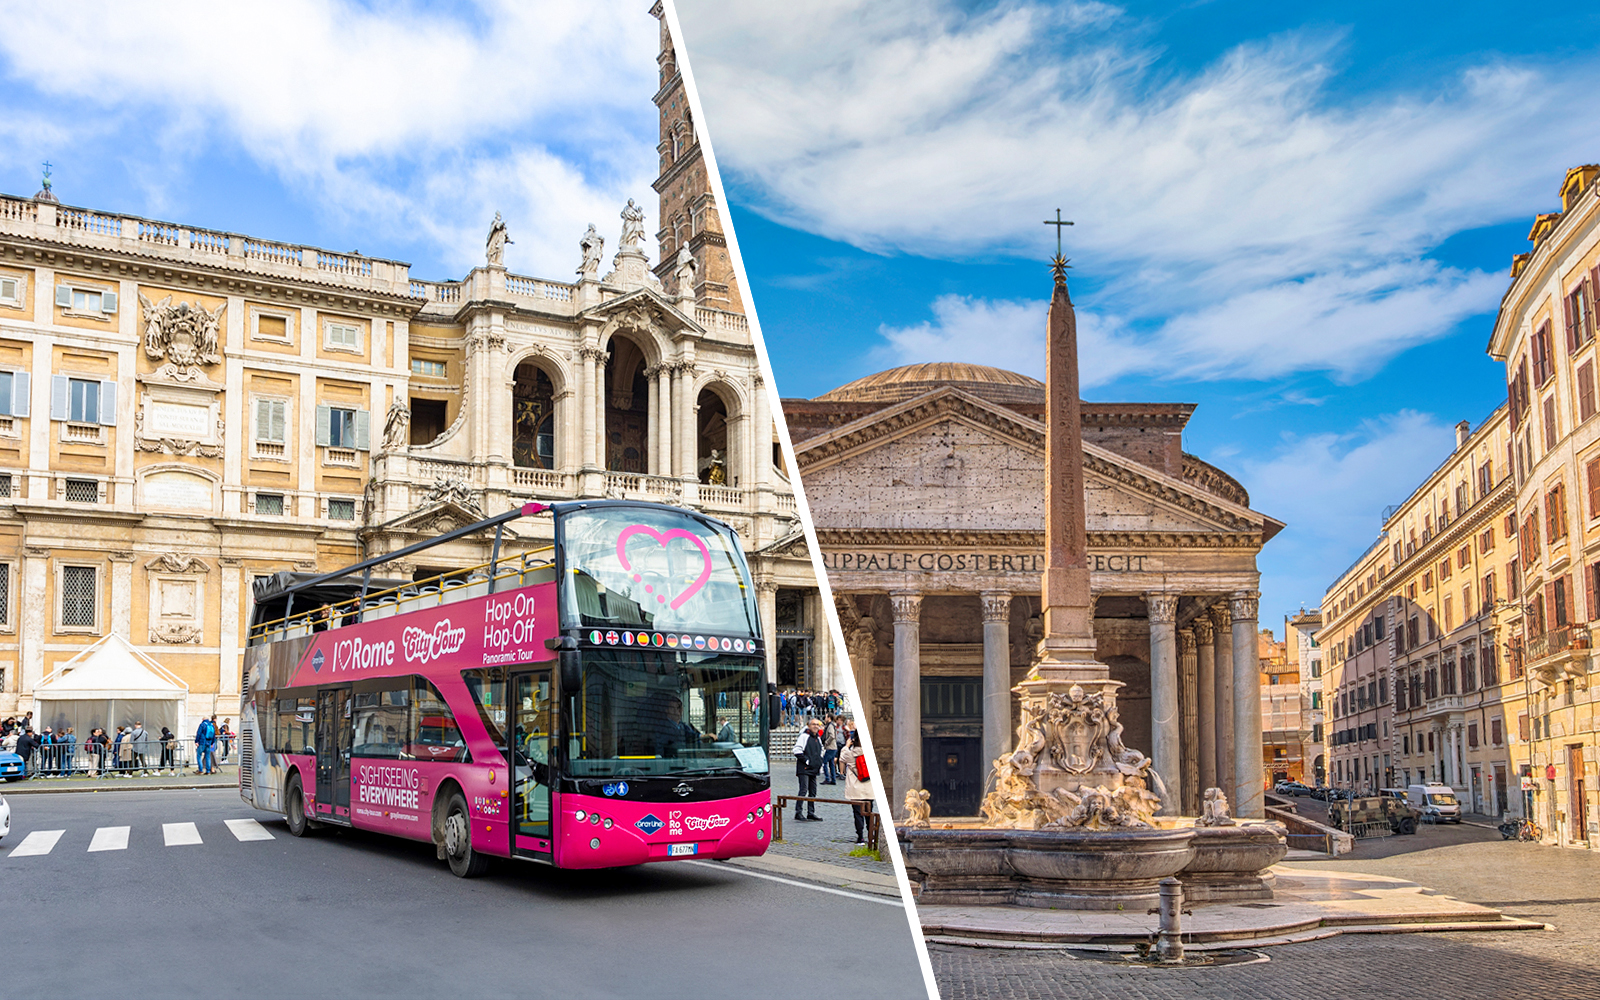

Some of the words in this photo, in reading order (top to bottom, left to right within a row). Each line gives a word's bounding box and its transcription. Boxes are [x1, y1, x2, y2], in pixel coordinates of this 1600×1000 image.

[485, 593, 535, 625] Hop-On
[483, 617, 536, 652] Hop-Off
[332, 642, 338, 673] I
[352, 637, 395, 670] Rome
[482, 650, 516, 665] Panoramic
[517, 648, 534, 661] Tour
[360, 765, 419, 789] SIGHTSEEING
[360, 785, 418, 809] EVERYWHERE
[669, 820, 680, 828] Ro
[669, 828, 683, 836] me
